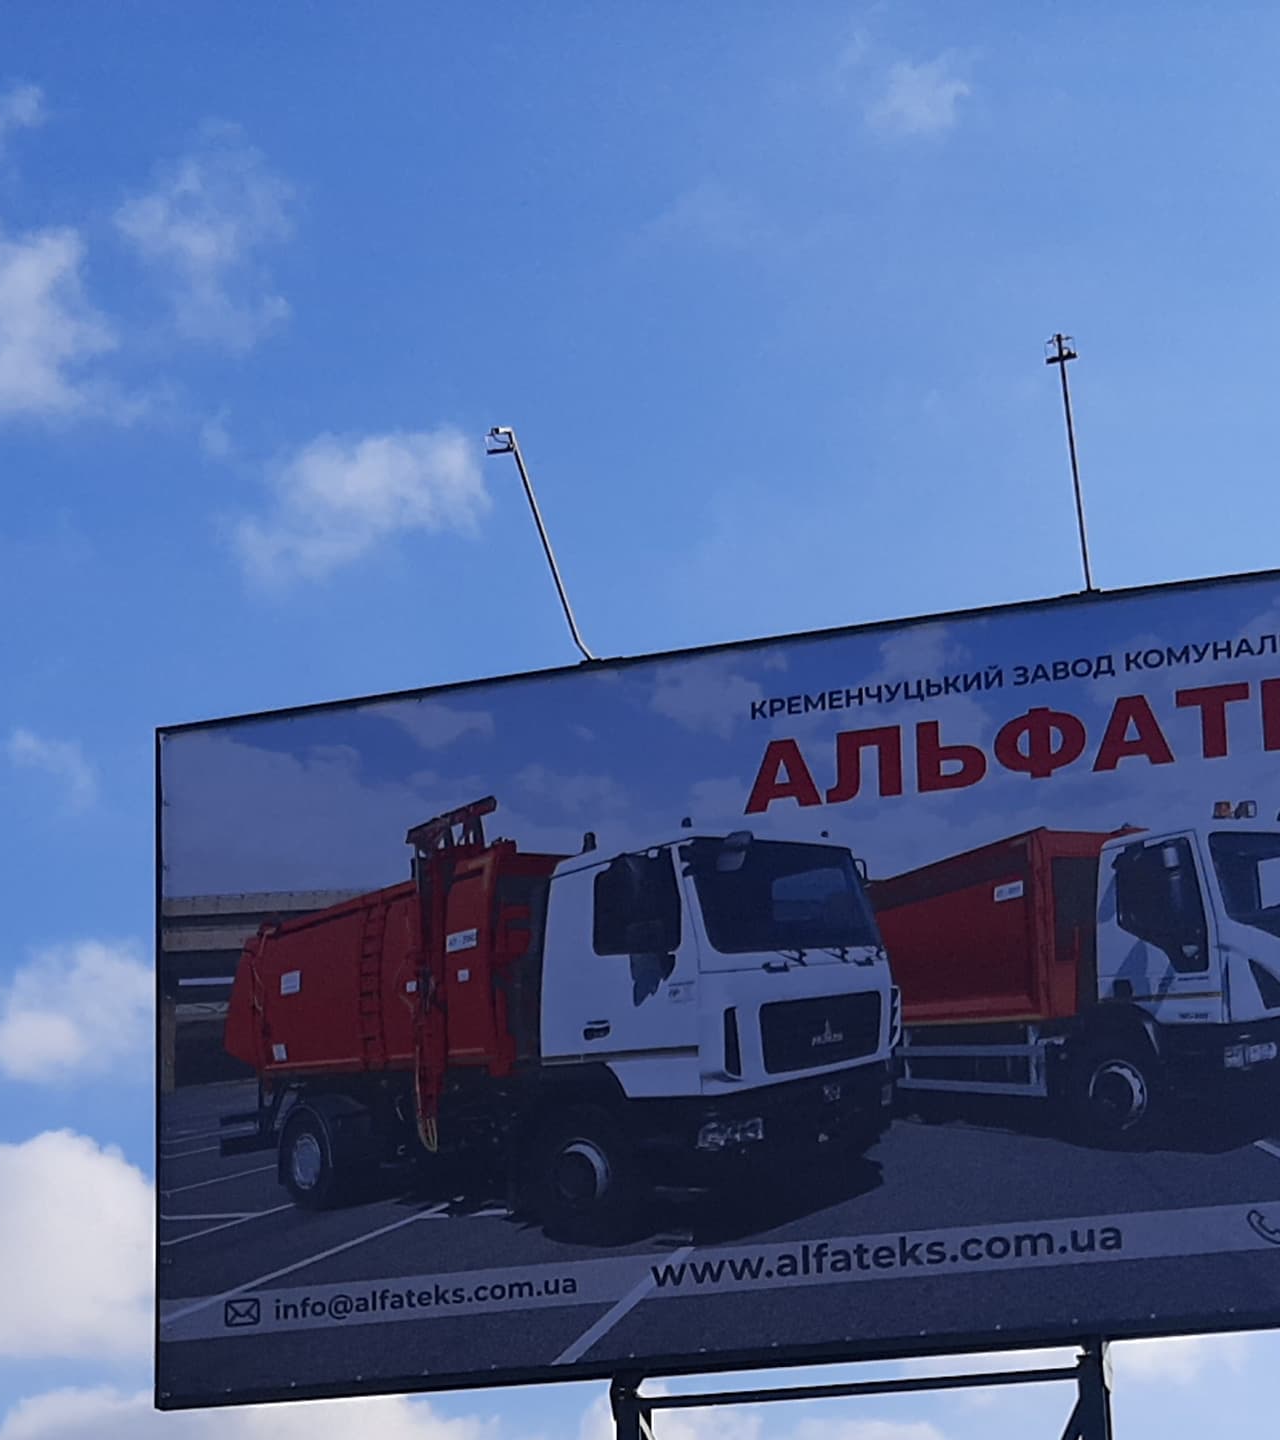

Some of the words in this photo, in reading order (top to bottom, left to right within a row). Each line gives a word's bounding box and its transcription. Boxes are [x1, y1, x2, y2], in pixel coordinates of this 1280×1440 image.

[750, 664, 1005, 720] КРЕМЕНЧУЦЬКИЙ
[1013, 652, 1117, 687] ЗАВОД
[650, 1222, 1123, 1287] www.alfateks.com.ua
[273, 1272, 578, 1322] info@alfateks.com.ua
